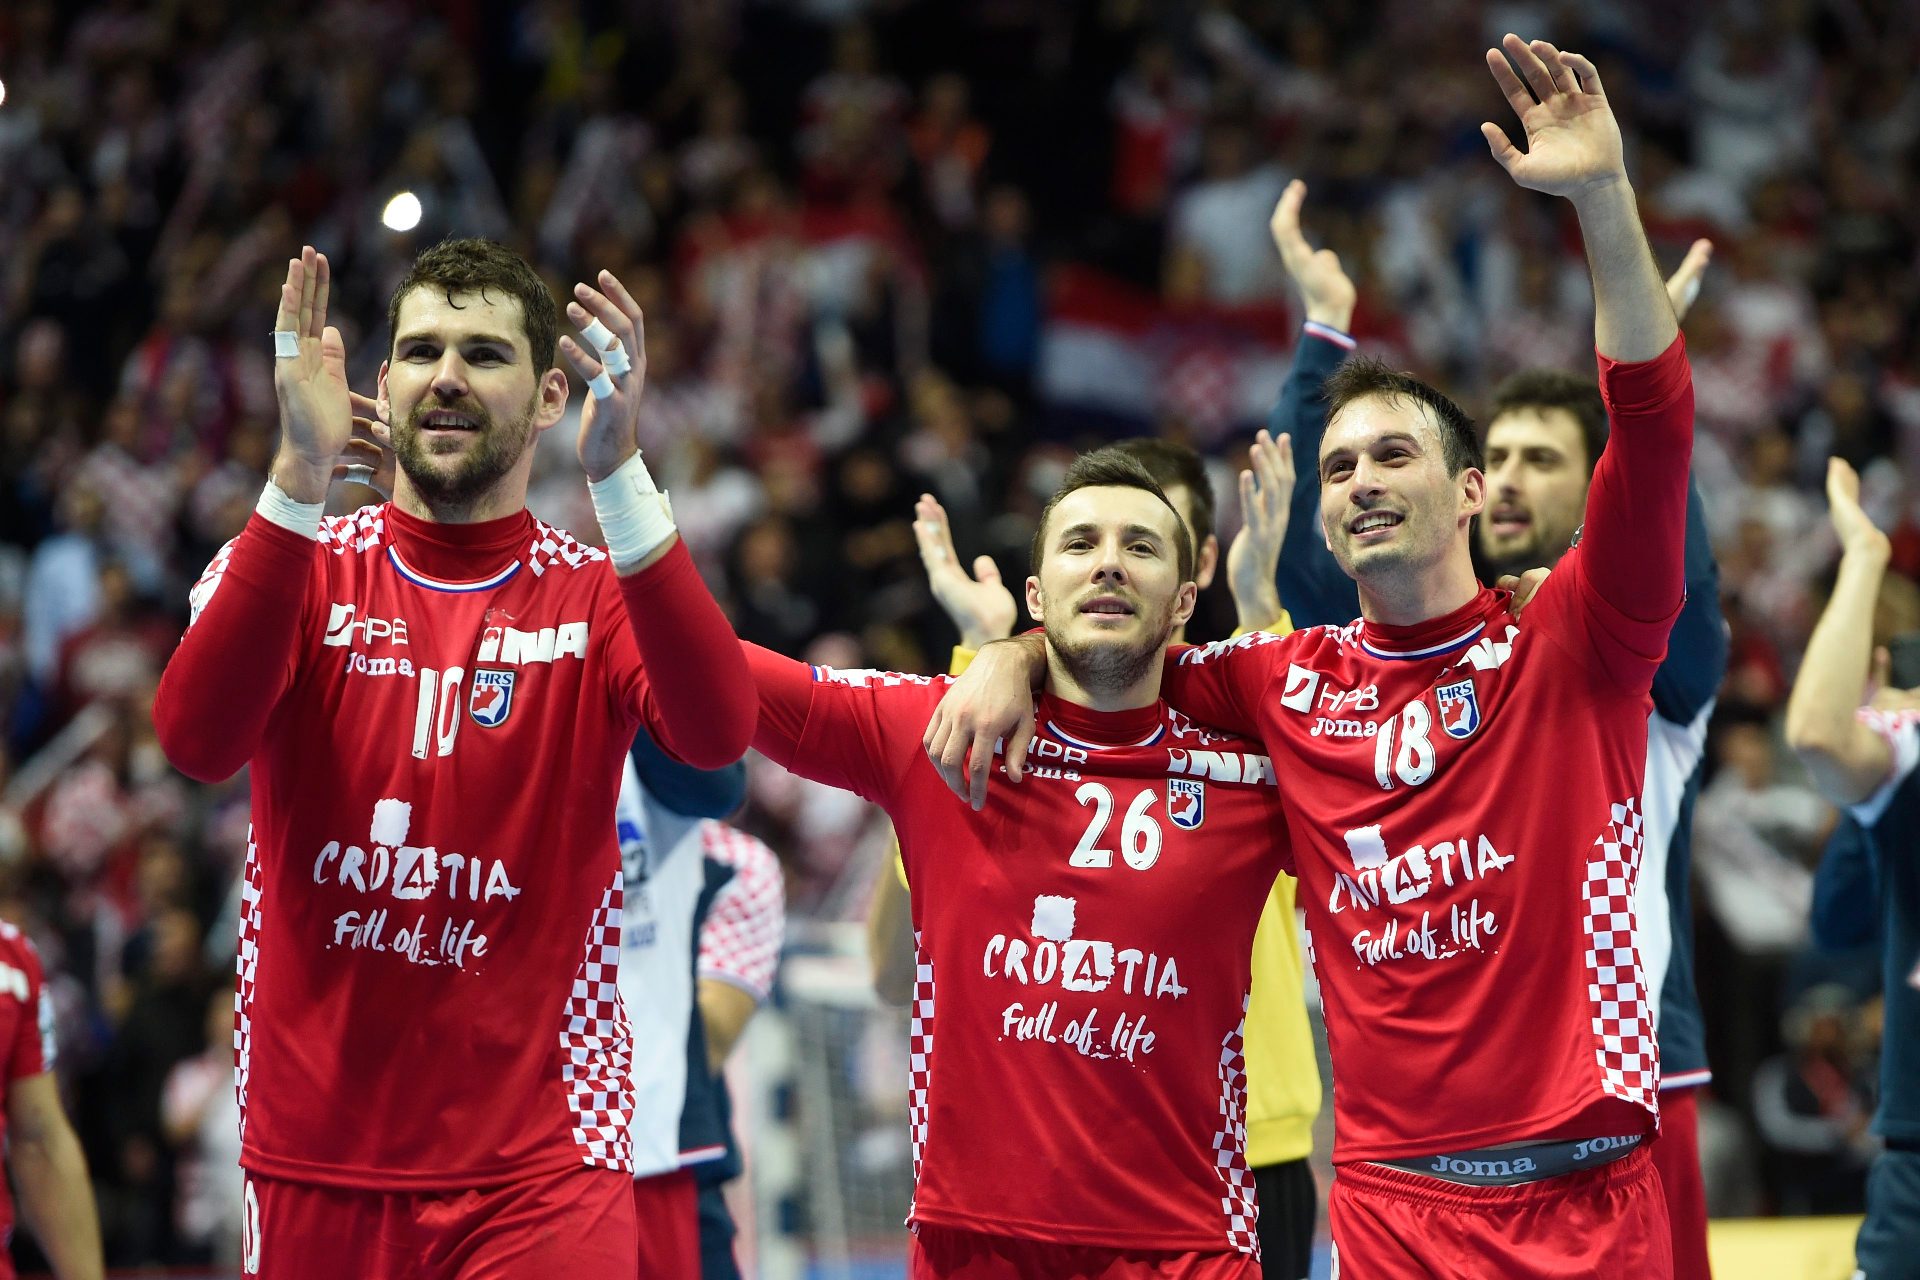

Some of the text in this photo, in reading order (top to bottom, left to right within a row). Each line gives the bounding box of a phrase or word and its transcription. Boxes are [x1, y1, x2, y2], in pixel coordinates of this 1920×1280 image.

[345, 652, 415, 677] Joma
[476, 673, 512, 685] HRS
[412, 666, 465, 760] 10
[1317, 682, 1380, 712] HPB
[1438, 682, 1472, 701] HRS
[1310, 717, 1378, 738] Joma
[1374, 700, 1436, 790] 18
[999, 760, 1082, 782] oma
[1170, 780, 1202, 794] HRS
[1069, 782, 1163, 871] 26
[313, 840, 521, 903] CROATIA
[334, 908, 488, 968] Full of life
[1352, 899, 1498, 965] Full of life
[983, 934, 1189, 1000] CROATIA
[1002, 1001, 1155, 1062] Full of life
[1431, 1155, 1537, 1176] Joma
